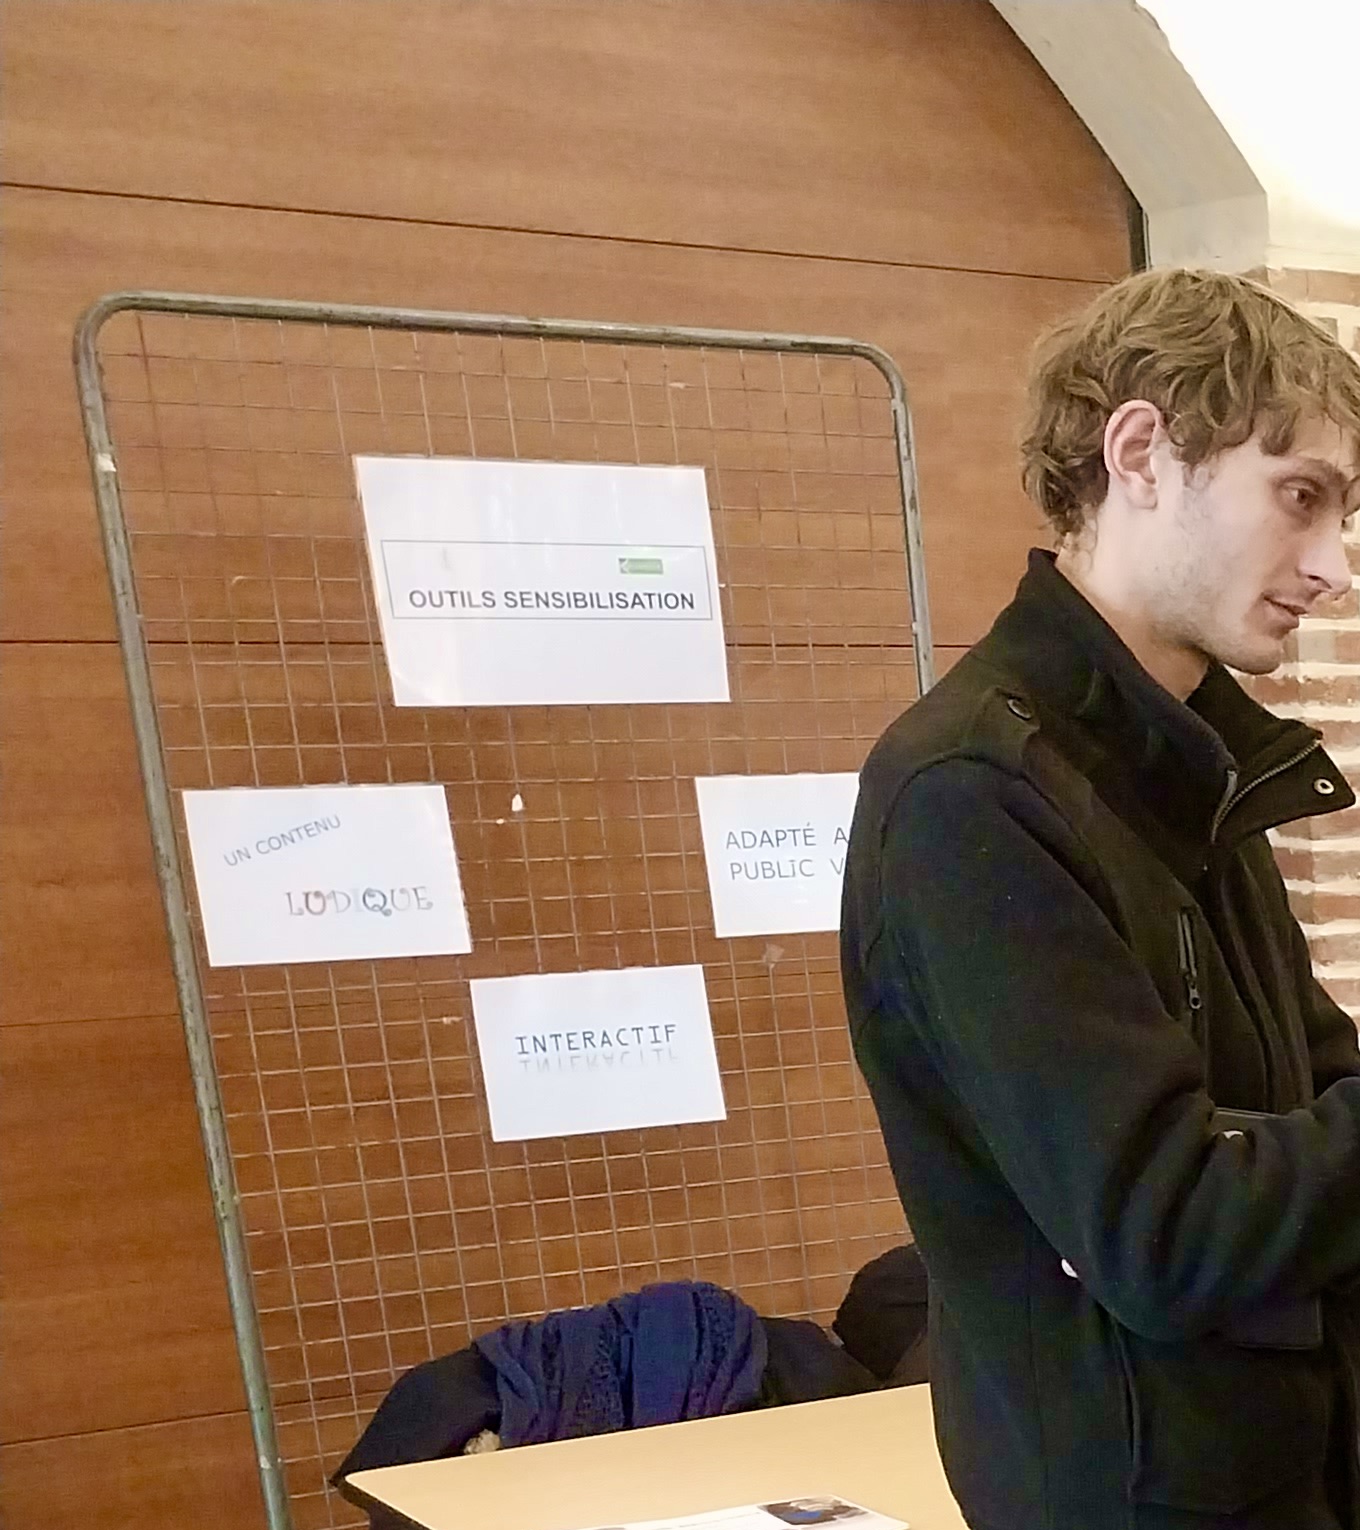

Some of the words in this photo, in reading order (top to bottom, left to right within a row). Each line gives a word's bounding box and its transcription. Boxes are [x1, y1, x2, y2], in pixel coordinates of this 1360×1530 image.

[408, 589, 497, 609] OUTILS
[503, 591, 695, 610] SENSIBILISATION
[223, 846, 252, 867] UN
[255, 814, 342, 855] CONTENU
[725, 821, 817, 850] ADAPTÉ
[285, 886, 434, 917] LUDIQUE
[515, 1023, 677, 1055] INTERACTIF
